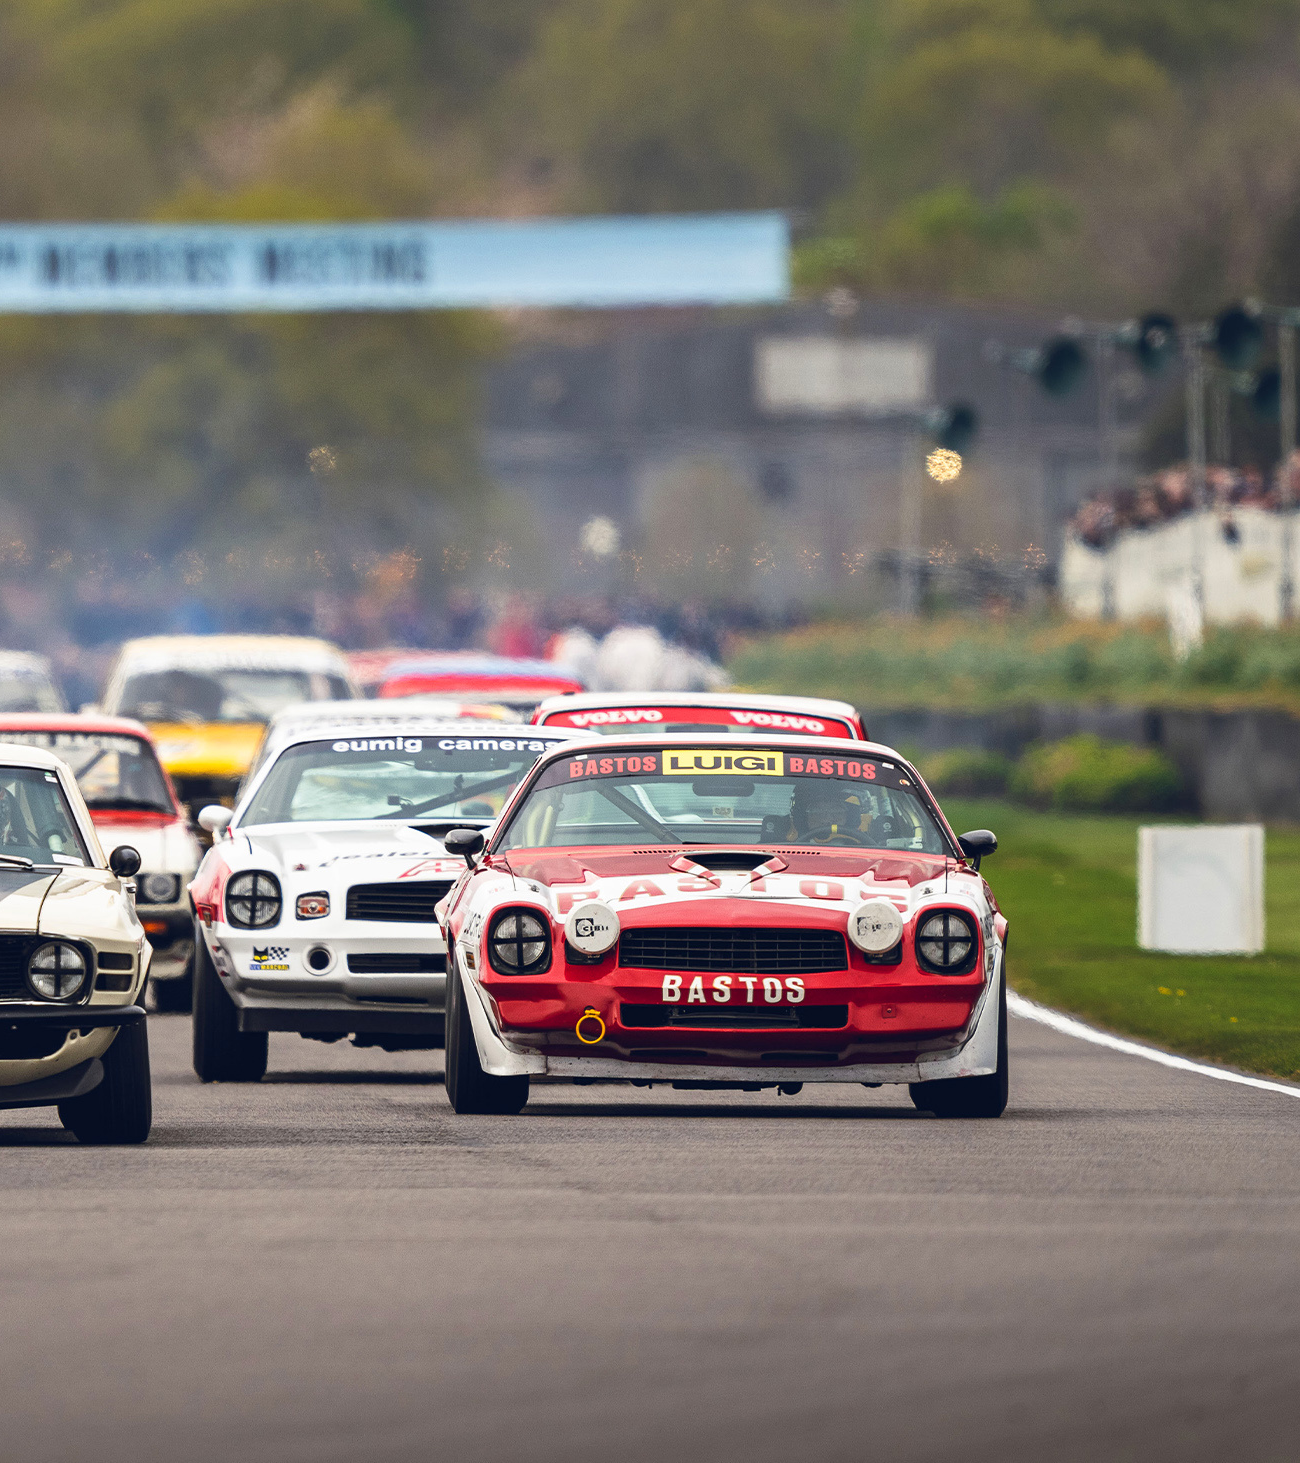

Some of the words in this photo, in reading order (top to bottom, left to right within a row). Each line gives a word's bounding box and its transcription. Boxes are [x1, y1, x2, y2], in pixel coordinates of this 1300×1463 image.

[568, 710, 663, 727] VOLVO
[728, 710, 826, 733] VOLVO
[332, 737, 423, 753] eumig
[569, 756, 657, 779] BASTOS
[670, 756, 776, 771] LUIGI
[789, 757, 877, 781] BASTOS
[661, 974, 806, 1004] BASTOS
